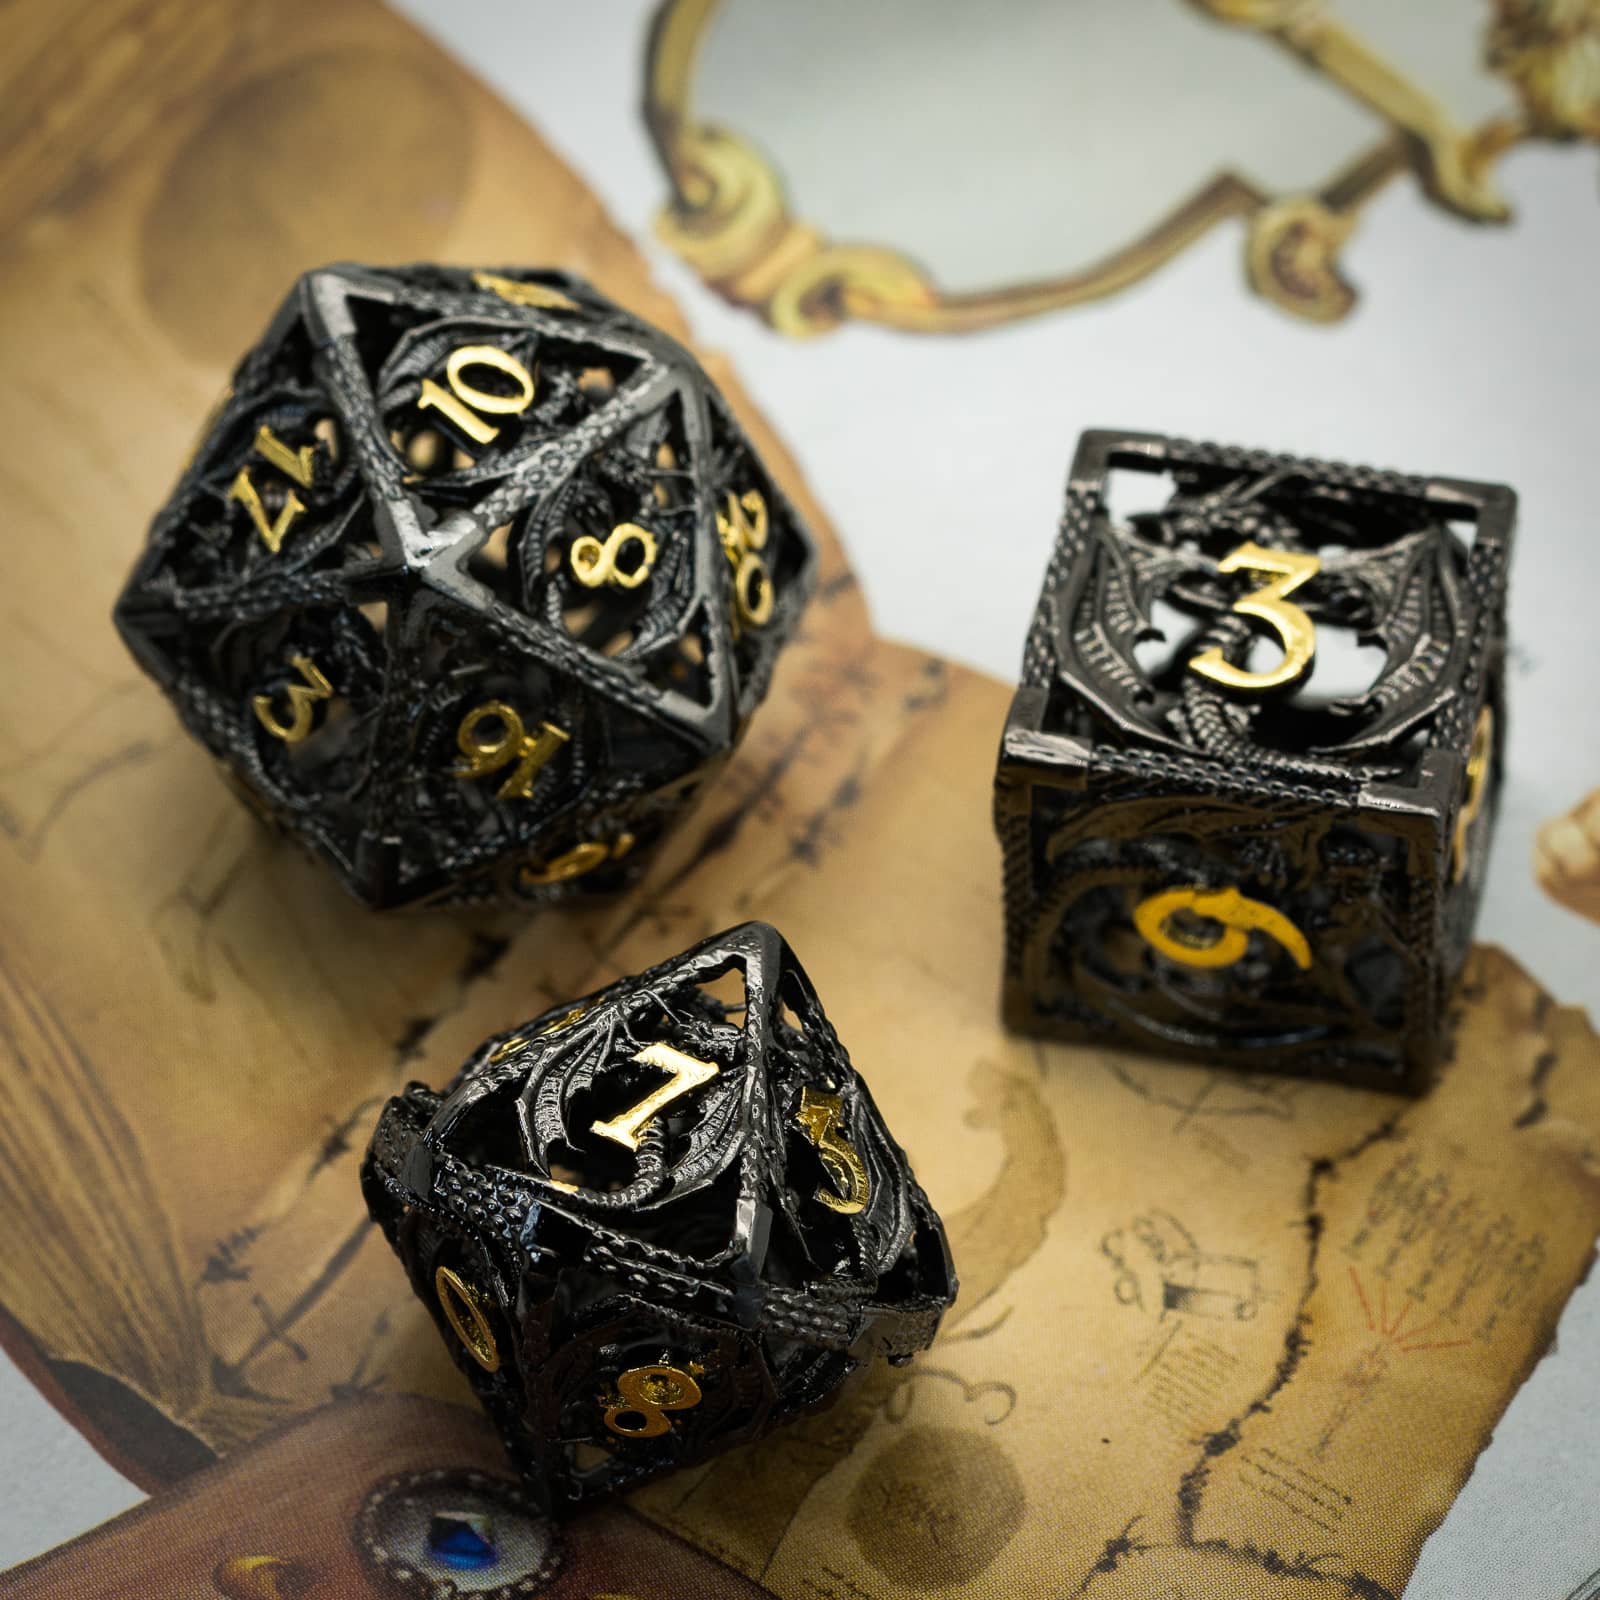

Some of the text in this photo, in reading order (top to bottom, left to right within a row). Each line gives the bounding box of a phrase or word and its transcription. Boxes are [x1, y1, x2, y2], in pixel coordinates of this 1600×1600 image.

[417, 345, 534, 444] 10
[227, 425, 315, 553] 17
[570, 523, 657, 588] 8
[1188, 540, 1321, 689] 3
[253, 656, 334, 742] 3
[436, 1266, 499, 1373] 0
[603, 1364, 702, 1437] 8
